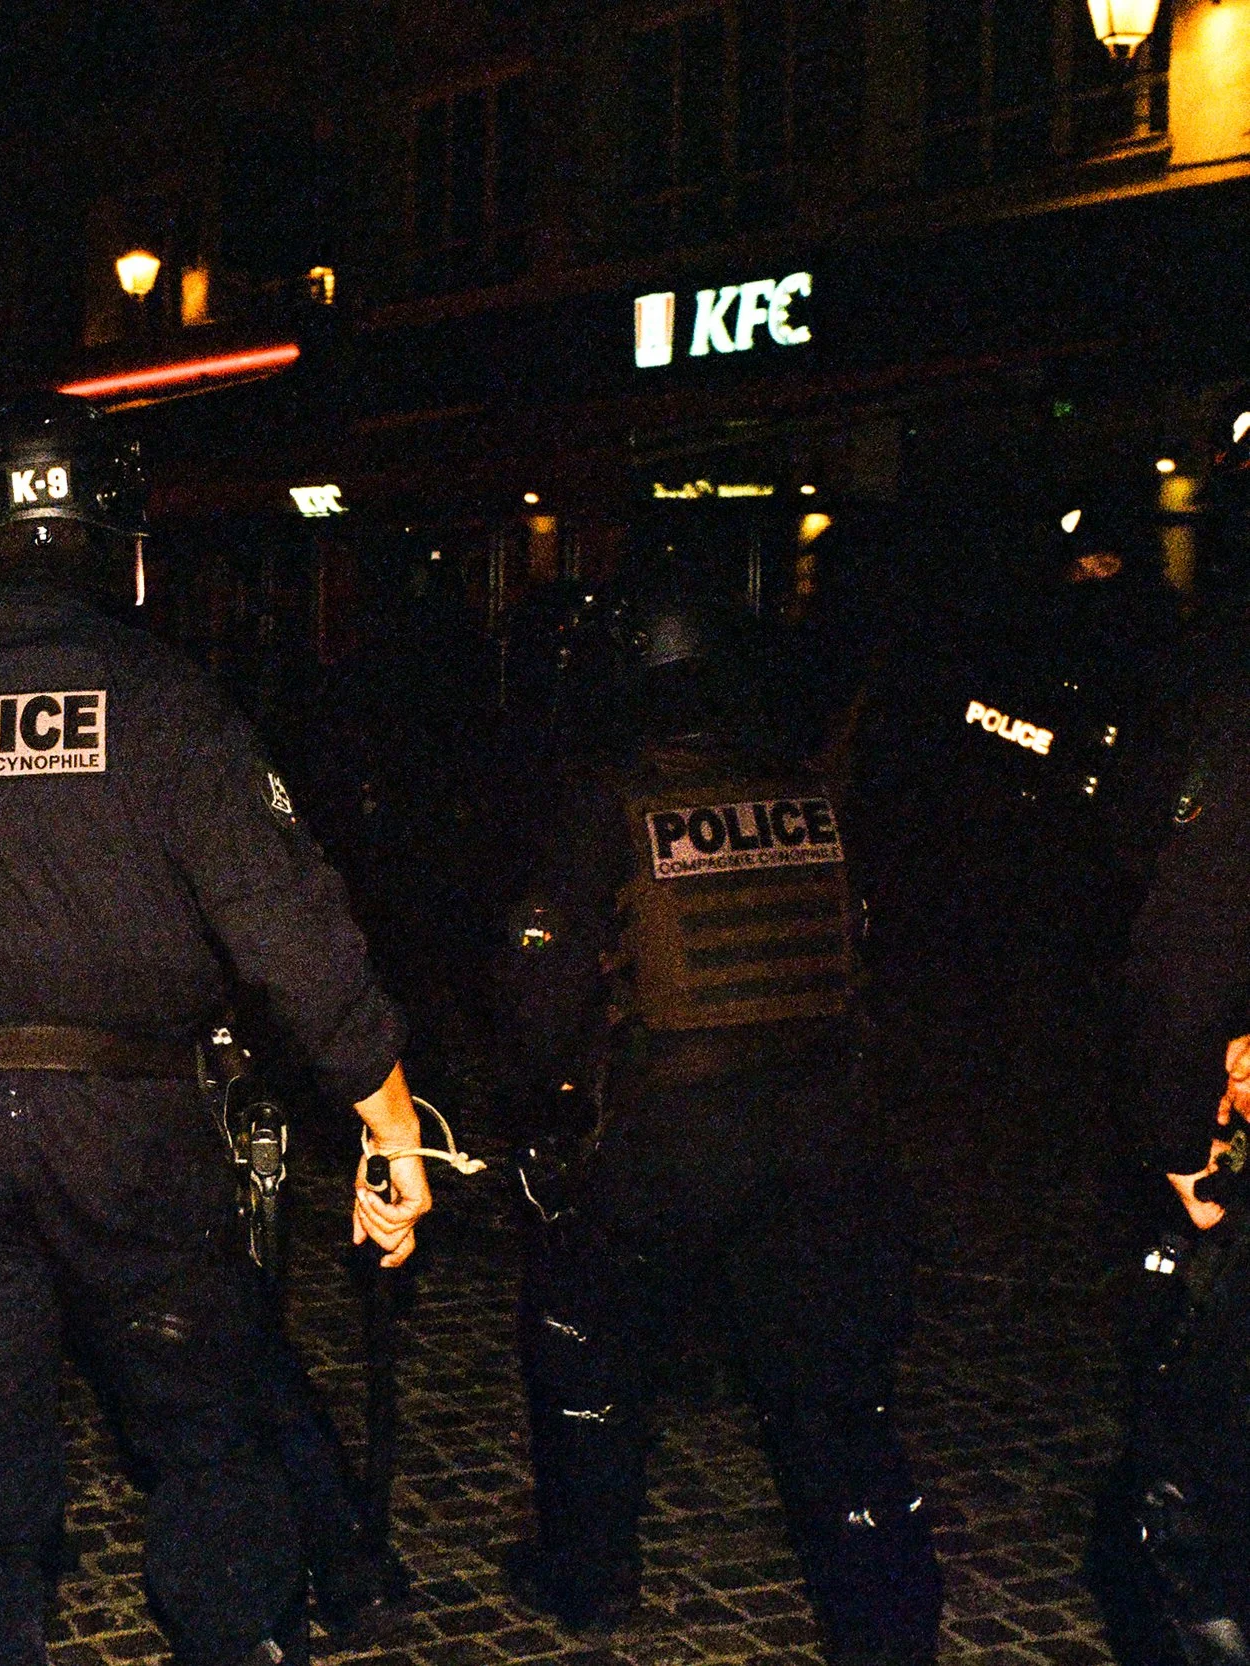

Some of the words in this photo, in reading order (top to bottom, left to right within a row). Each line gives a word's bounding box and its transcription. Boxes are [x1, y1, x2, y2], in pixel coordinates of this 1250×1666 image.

[688, 272, 813, 356] KFC
[11, 467, 69, 503] K-9
[965, 700, 1054, 755] POLICE
[653, 801, 837, 859] POLICE
